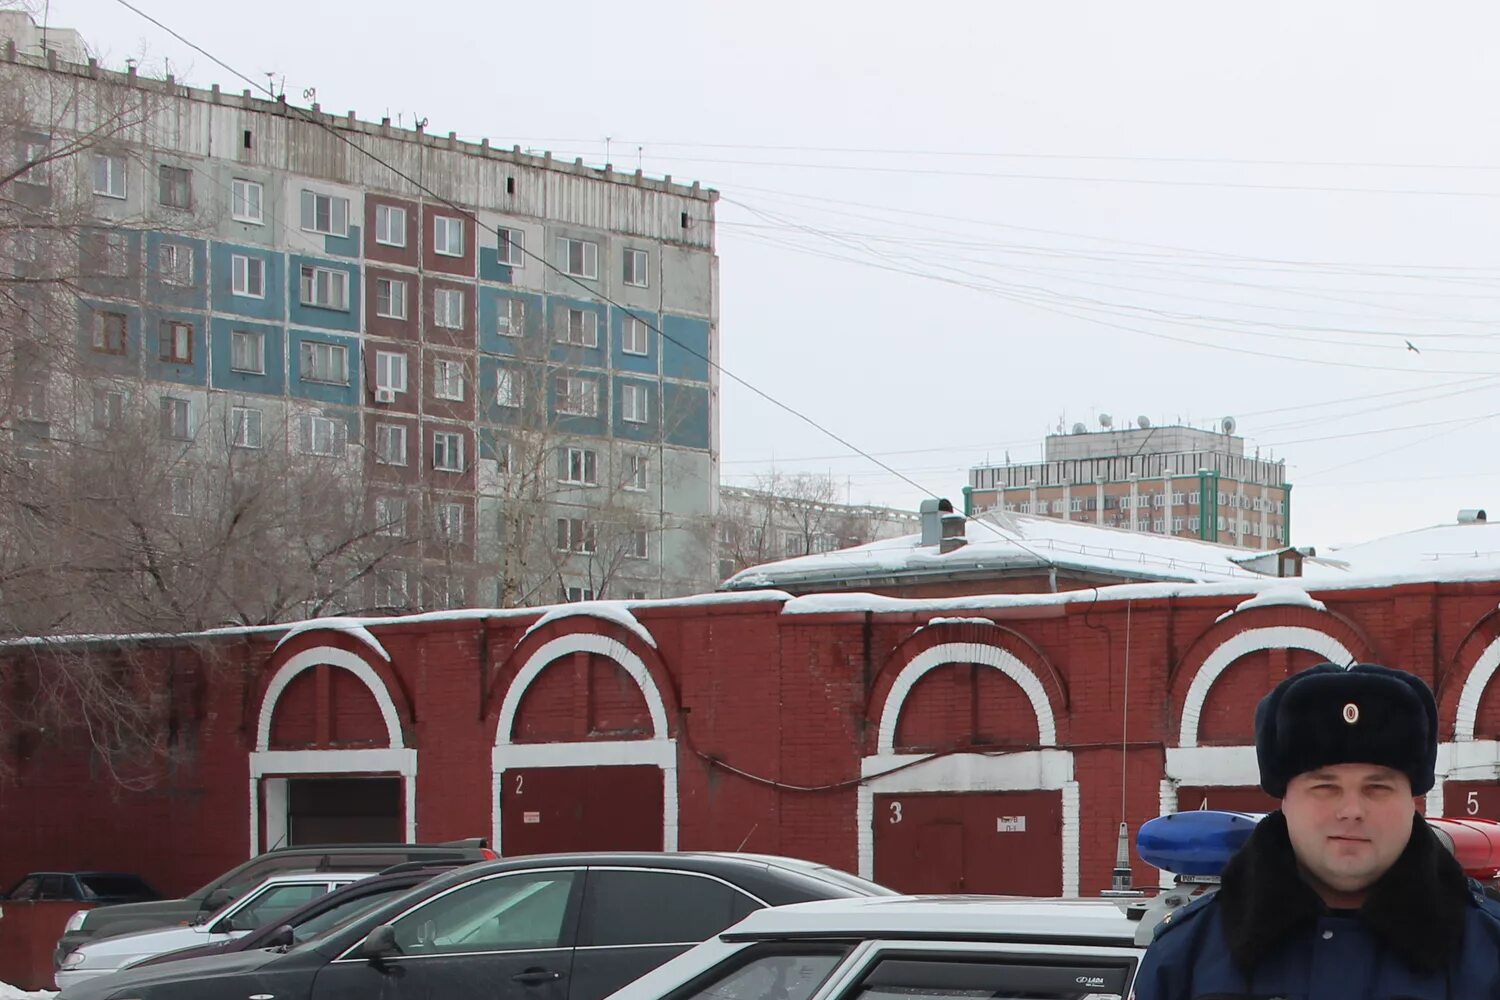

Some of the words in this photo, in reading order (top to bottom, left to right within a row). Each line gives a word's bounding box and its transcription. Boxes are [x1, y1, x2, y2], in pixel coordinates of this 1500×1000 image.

[515, 774, 523, 794] 2
[889, 801, 902, 824] 3
[1466, 791, 1479, 815] 5
